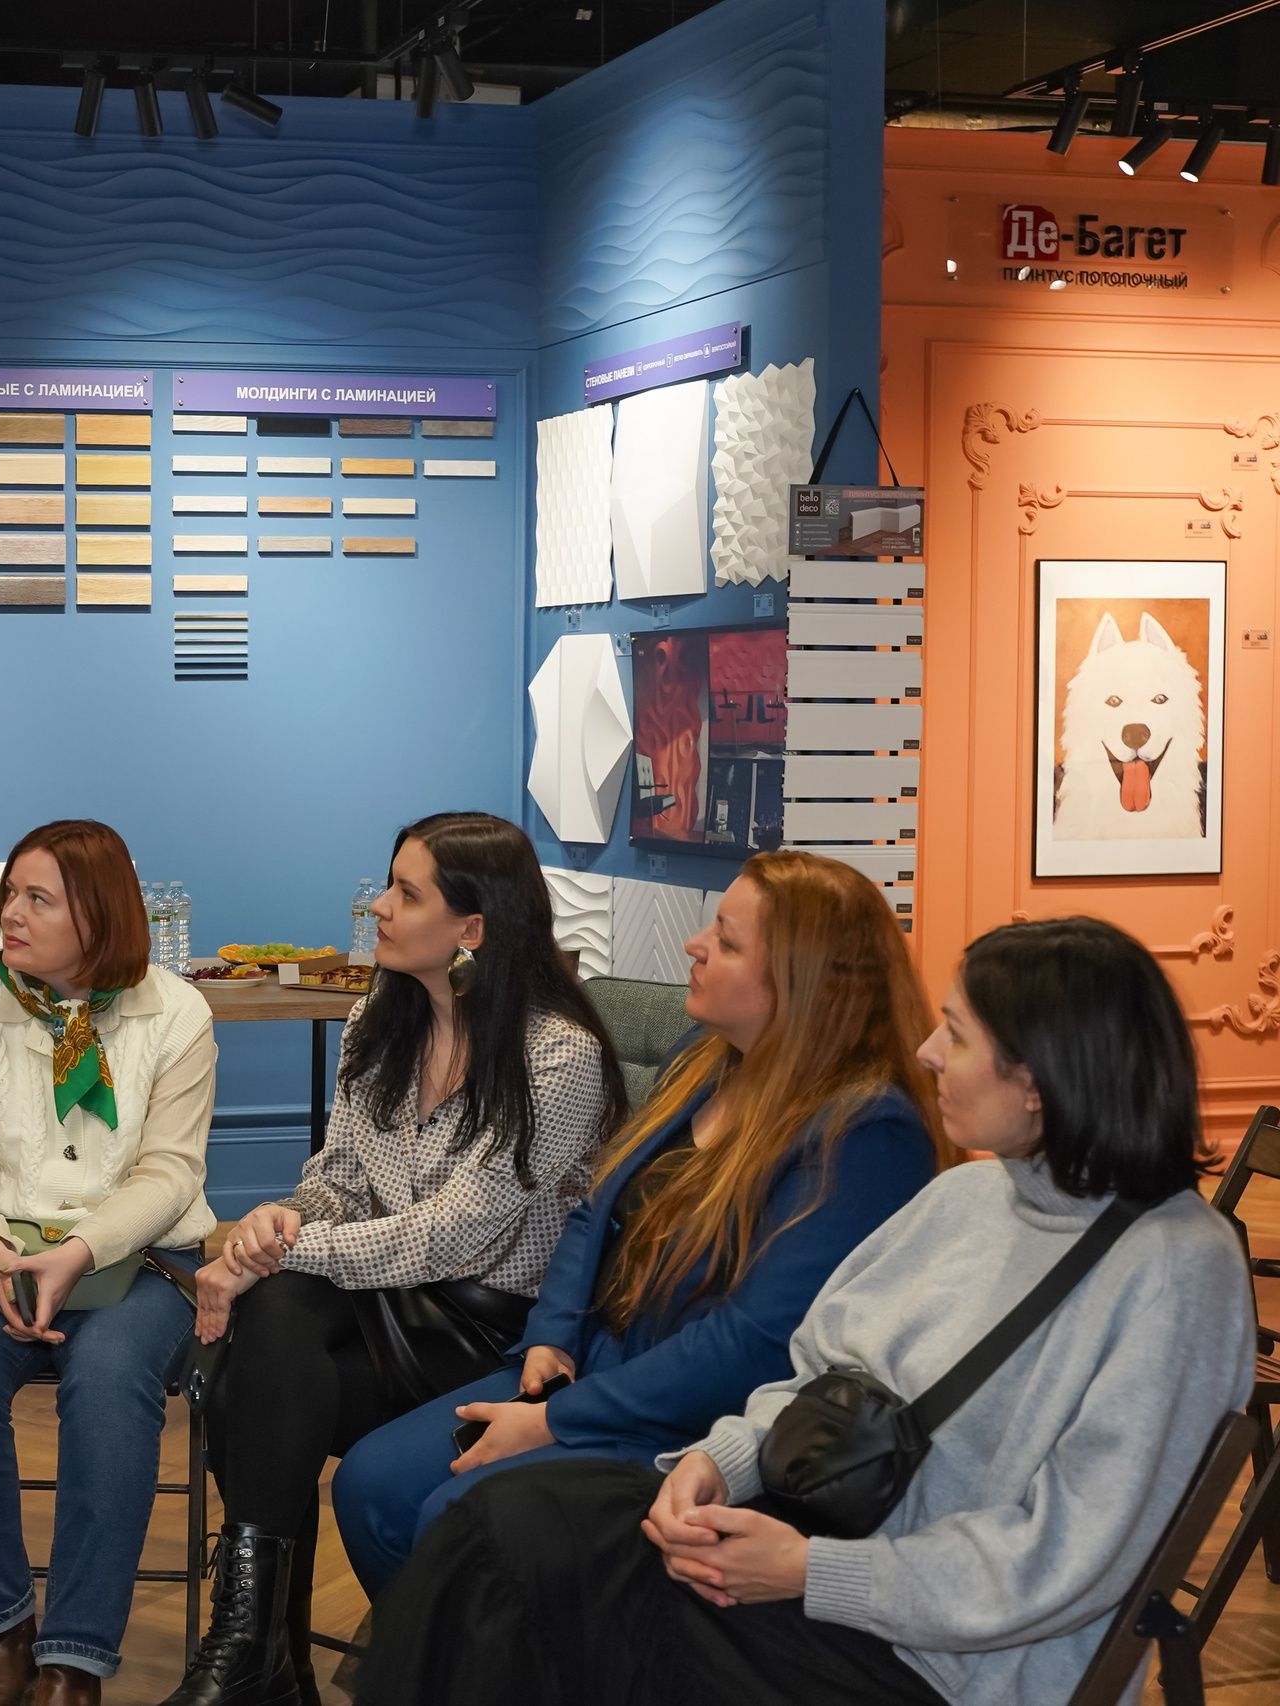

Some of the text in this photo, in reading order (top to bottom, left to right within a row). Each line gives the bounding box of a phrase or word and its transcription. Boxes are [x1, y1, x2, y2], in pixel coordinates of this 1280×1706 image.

[1006, 210, 1187, 259] Де-Багет
[585, 371, 613, 388] СТЕНОВЫЕ
[613, 365, 635, 380] ПАНЕЛИ
[24, 383, 34, 396] С
[38, 382, 145, 399] ЛАМИНАЦИЕЙ
[236, 386, 437, 404] МОЛДИНГИ С ЛАМИНАЦИЕЙ
[800, 489, 819, 502] bello
[800, 504, 819, 512] deco
